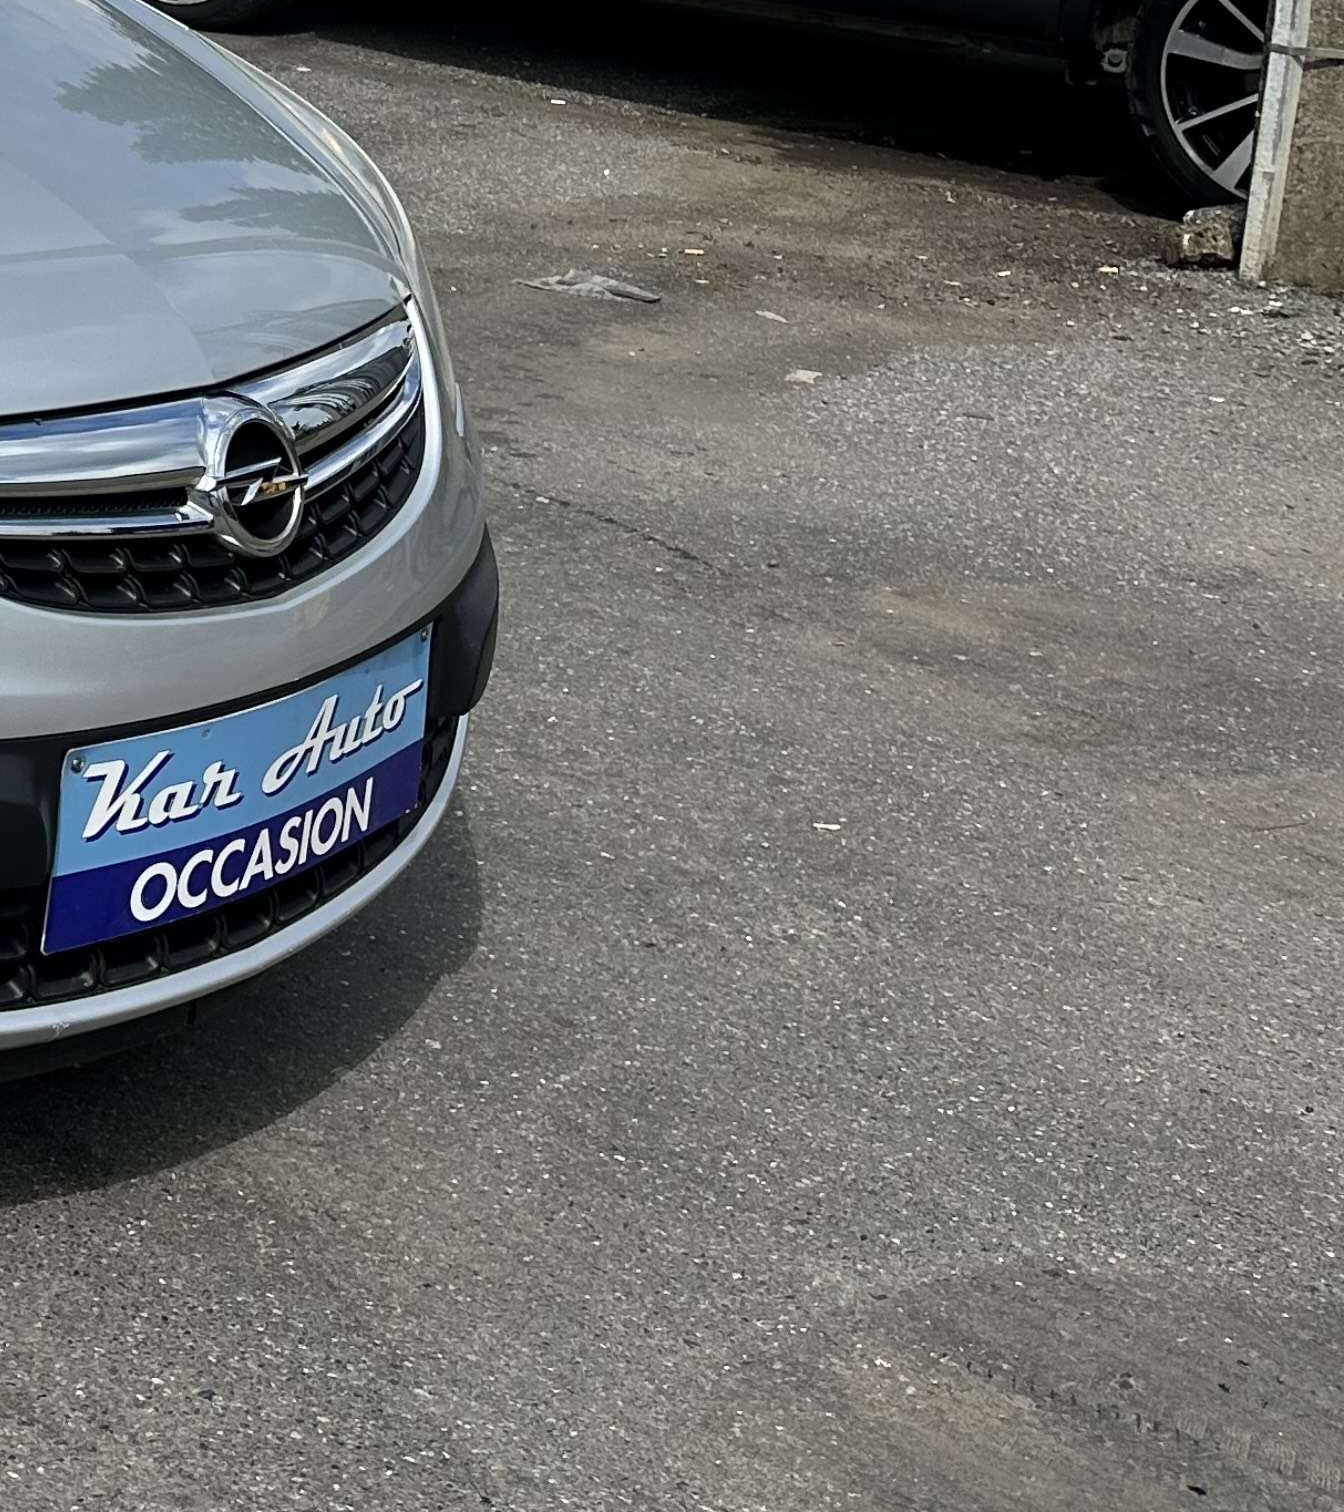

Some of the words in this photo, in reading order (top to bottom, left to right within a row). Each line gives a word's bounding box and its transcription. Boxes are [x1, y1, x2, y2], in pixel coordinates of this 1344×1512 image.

[81, 749, 242, 840] Kar
[261, 678, 422, 796] Auto
[129, 777, 374, 922] OCCASION
